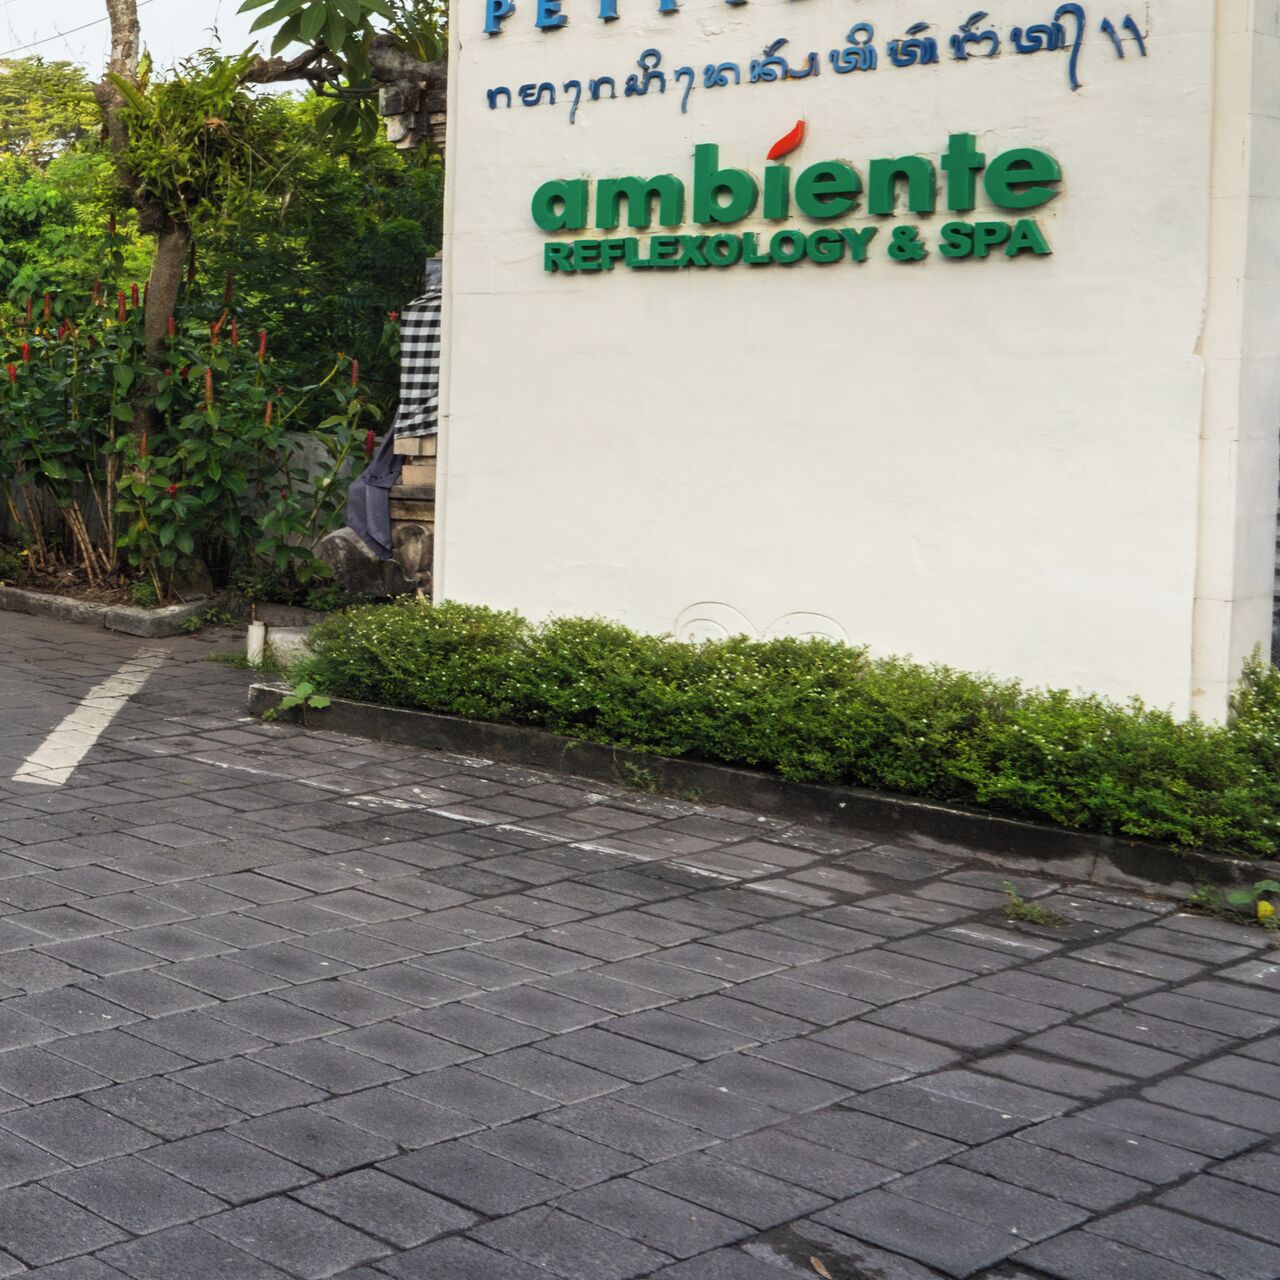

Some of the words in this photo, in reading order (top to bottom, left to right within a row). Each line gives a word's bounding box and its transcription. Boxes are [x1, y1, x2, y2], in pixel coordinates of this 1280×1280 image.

[530, 120, 1064, 233] ambiente
[543, 225, 878, 274] REFLEXOLOGY
[887, 224, 927, 263] &
[938, 218, 1051, 260] SPA
